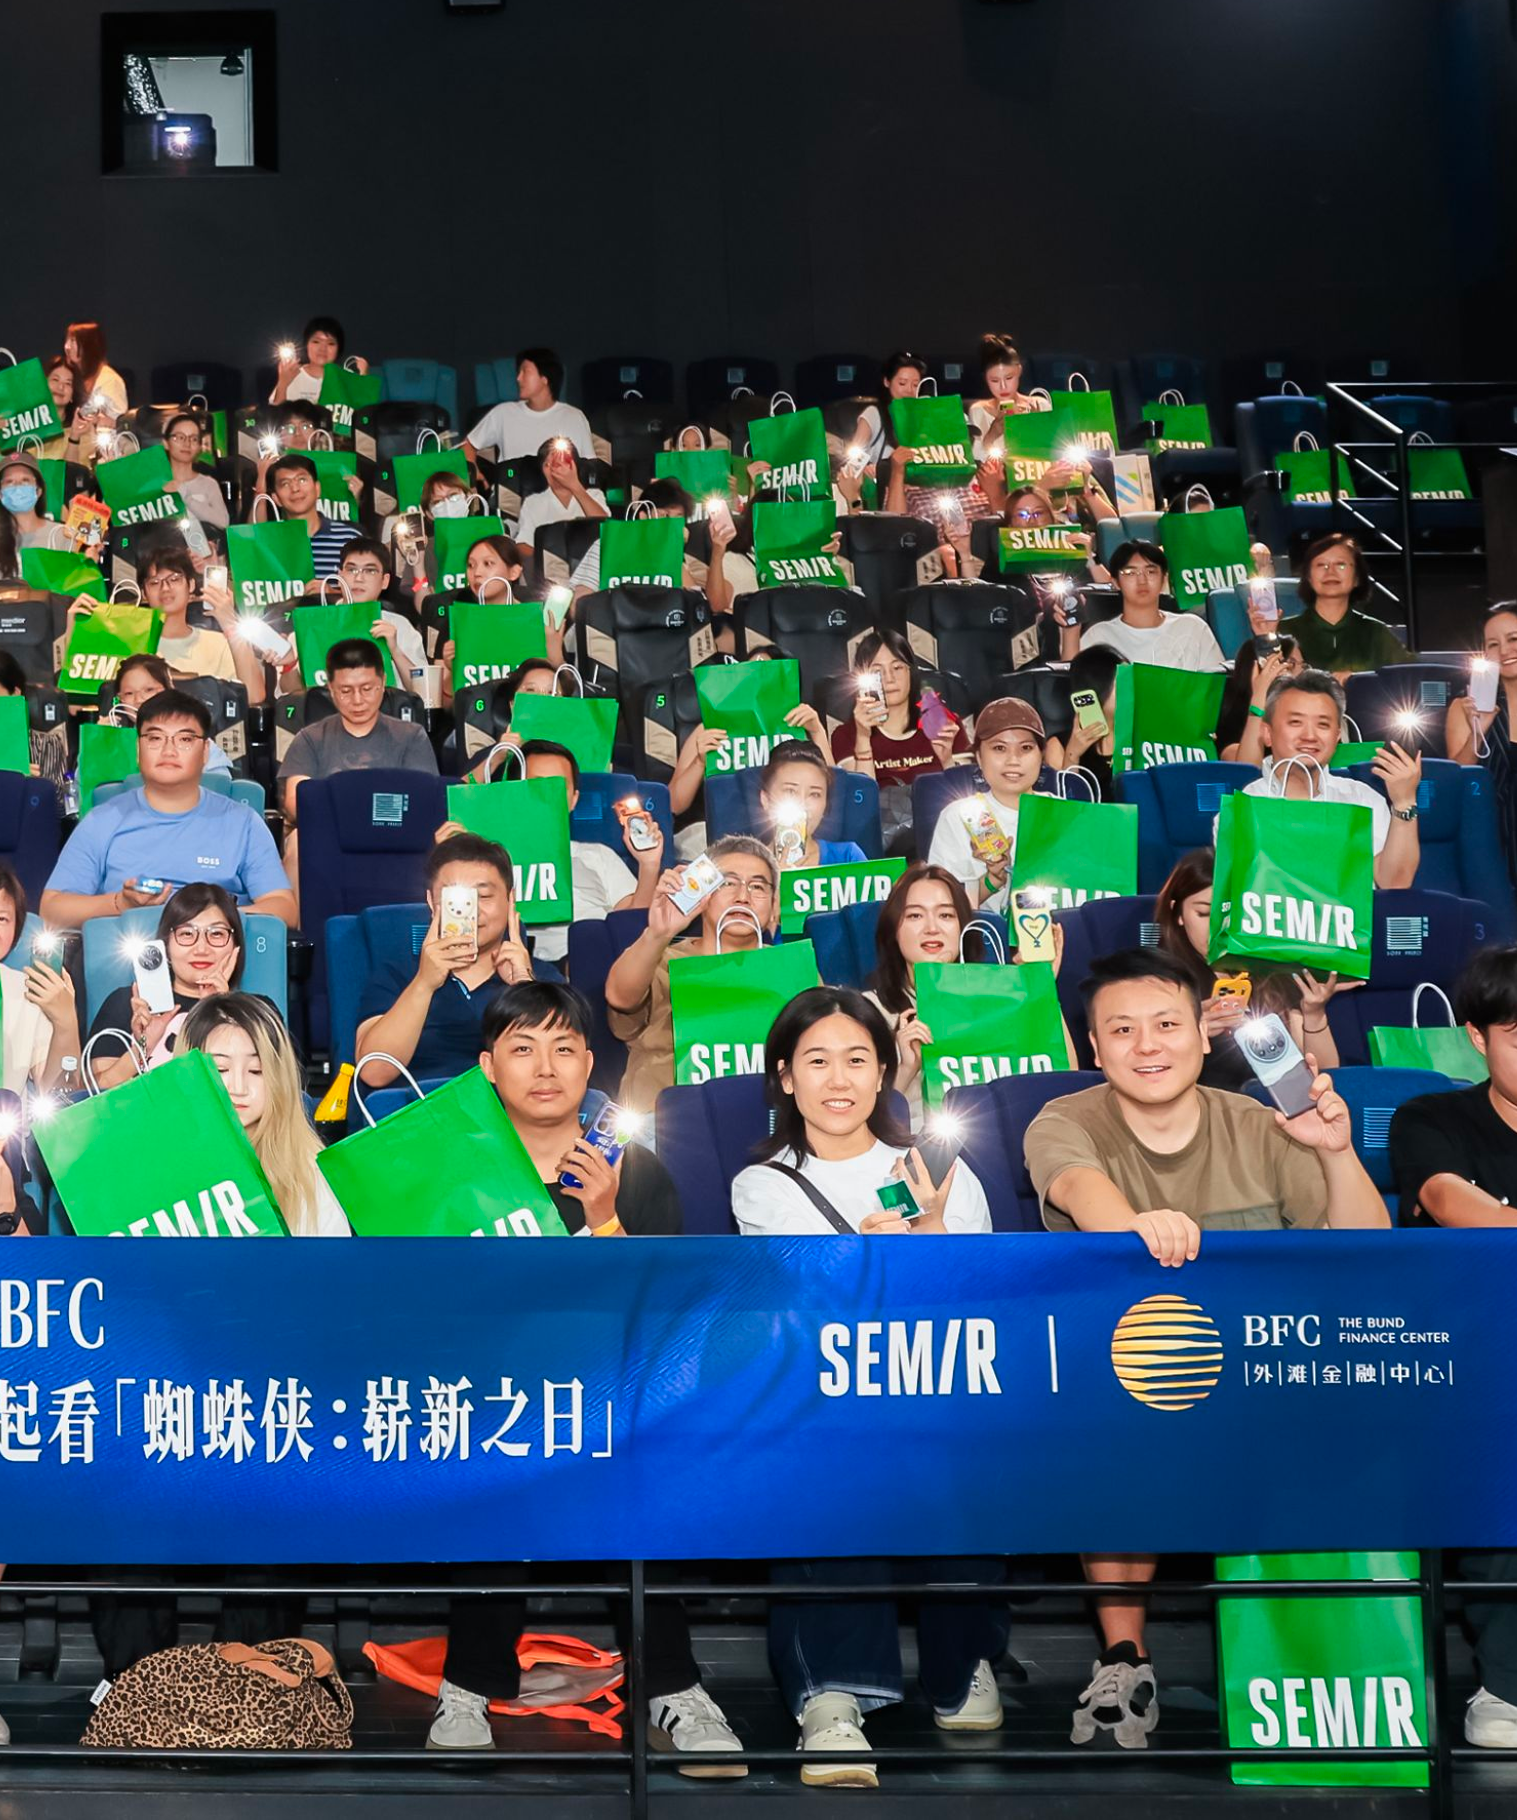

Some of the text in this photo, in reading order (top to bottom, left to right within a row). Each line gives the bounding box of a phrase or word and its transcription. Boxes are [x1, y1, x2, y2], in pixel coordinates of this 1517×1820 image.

[476, 700, 484, 711] 6
[657, 696, 665, 708] 5
[287, 707, 294, 718] 7
[902, 754, 933, 767] Maker
[1471, 782, 1481, 797] 2
[854, 790, 863, 803] 5
[256, 937, 267, 952] 8
[1338, 1317, 1405, 1328] THE BUND
[1243, 1315, 1321, 1347] BFC
[1339, 1332, 1450, 1344] FINANCE CENTER
